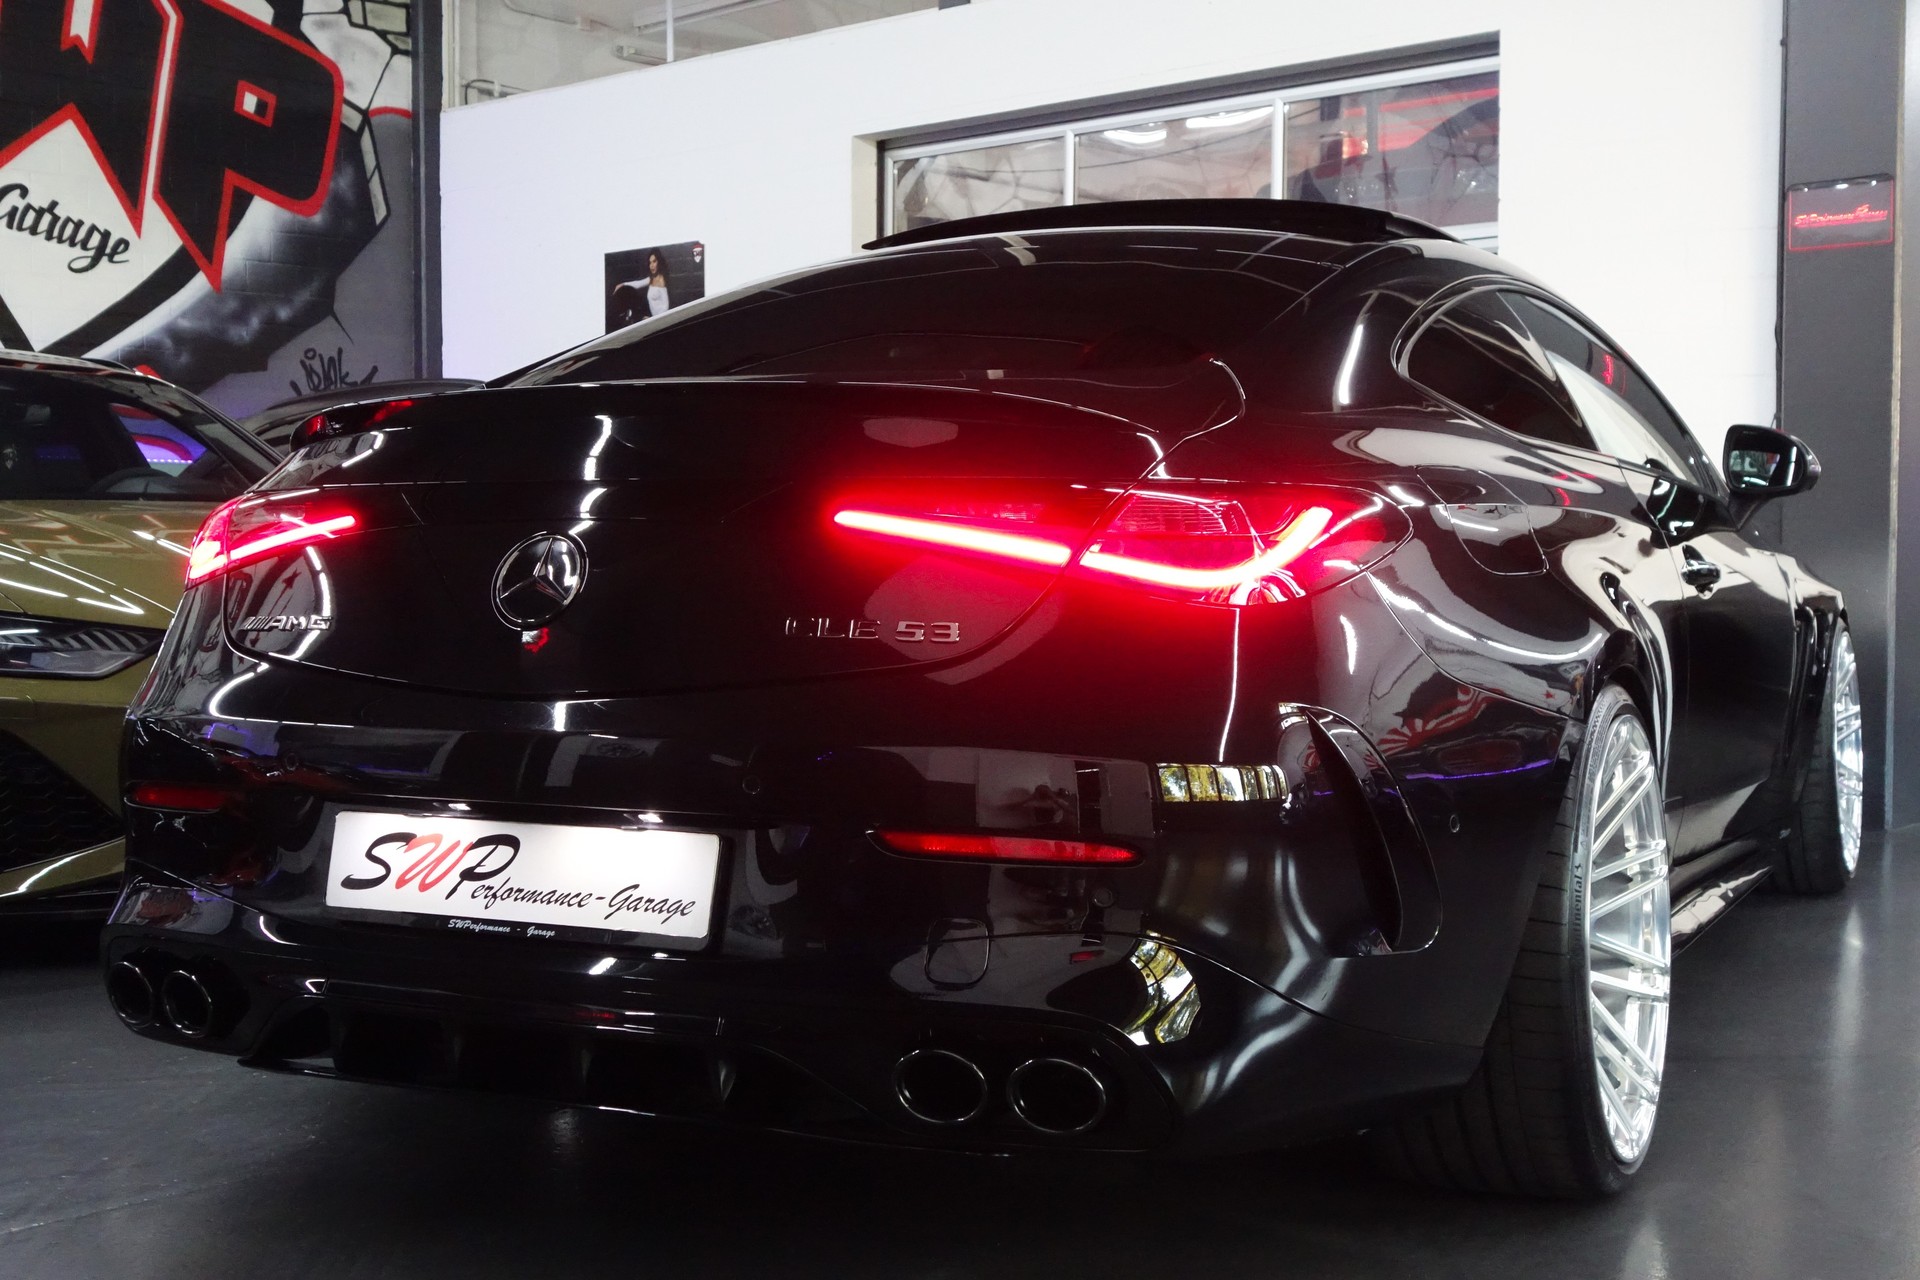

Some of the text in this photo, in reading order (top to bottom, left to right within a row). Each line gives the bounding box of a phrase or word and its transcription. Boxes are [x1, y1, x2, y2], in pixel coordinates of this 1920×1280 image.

[0, 183, 130, 273] Garage
[895, 620, 960, 642] 53
[447, 919, 511, 932] SWPerformance
[526, 925, 556, 938] Garage
